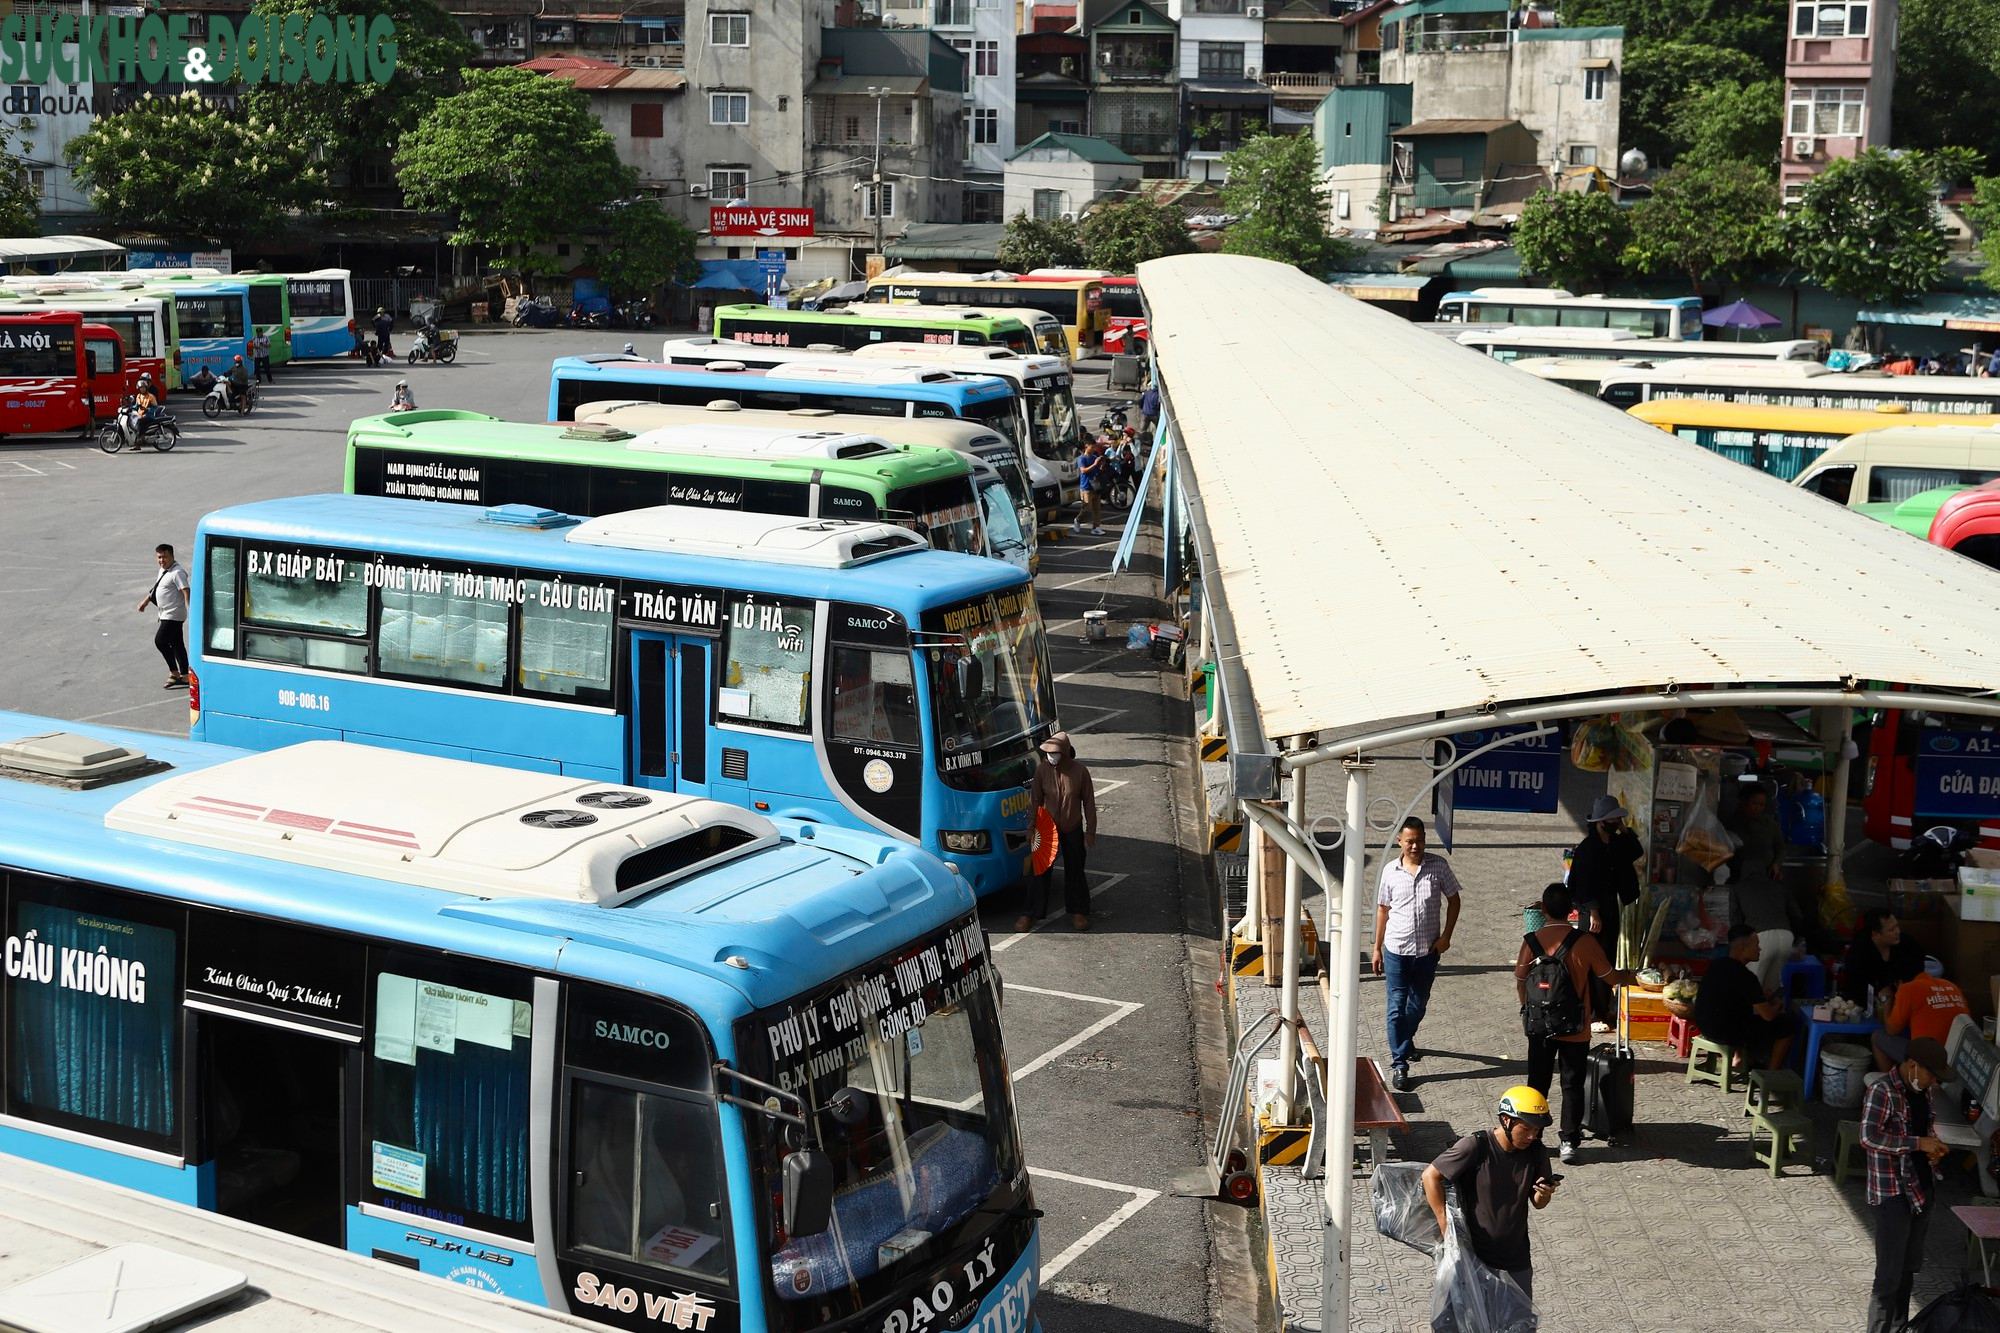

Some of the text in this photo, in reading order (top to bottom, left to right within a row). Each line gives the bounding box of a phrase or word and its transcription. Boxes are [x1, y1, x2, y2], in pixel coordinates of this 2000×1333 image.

[729, 210, 809, 228] NHÀ VỆ SINH
[19, 330, 51, 351] NỘI
[387, 462, 404, 476] NAM
[405, 464, 423, 478] ĐỊNH
[443, 467, 457, 481] LẠC
[386, 480, 406, 495] XUÂN
[407, 482, 436, 498] TRƯỜNG
[463, 488, 480, 502] NHA
[670, 485, 685, 499] Kính
[685, 486, 701, 501] Chào
[716, 490, 735, 504] Khách
[833, 497, 863, 507] SAMCO
[248, 549, 273, 575] B.X
[315, 552, 345, 583] BÁT
[363, 554, 406, 589] ĐỒNG
[411, 562, 443, 594] VĂN
[453, 567, 485, 600] HÒA
[490, 576, 528, 608] MẠC
[539, 573, 573, 609] CẦU
[577, 582, 616, 613] GIÁT
[633, 589, 676, 621] TRÁC
[681, 592, 717, 625] VĂN
[733, 593, 755, 630] LỖ
[759, 601, 784, 633] HÀ
[847, 616, 888, 631] SAMCO
[943, 602, 981, 633] NGUYÊN
[777, 636, 804, 653] Wifi
[278, 688, 330, 712] 90B-006.16
[1457, 765, 1544, 794] VĨNH TRỤ
[1939, 769, 1974, 795] CỬA
[5, 928, 146, 1004] CẦU KHÔNG
[203, 966, 234, 988] Kính
[235, 973, 264, 994] Chào
[266, 978, 290, 1003] Quý
[291, 983, 333, 1009] Khách
[943, 981, 961, 1008] B.X
[961, 967, 980, 997] GIÁP
[767, 1005, 803, 1062] PHỦ
[802, 1000, 823, 1047] LÝ
[829, 986, 858, 1032] CHỢ
[856, 974, 893, 1020] SÔNG
[893, 956, 921, 999] VĨNH
[920, 945, 943, 985] TRỤ
[595, 1019, 670, 1050] SAMCO
[779, 1063, 809, 1093] B.X
[808, 1049, 845, 1085] VĨNH
[963, 1236, 997, 1293] LÝ
[574, 1271, 716, 1331] SAO VIỆT
[948, 1298, 980, 1329] SAMCO
